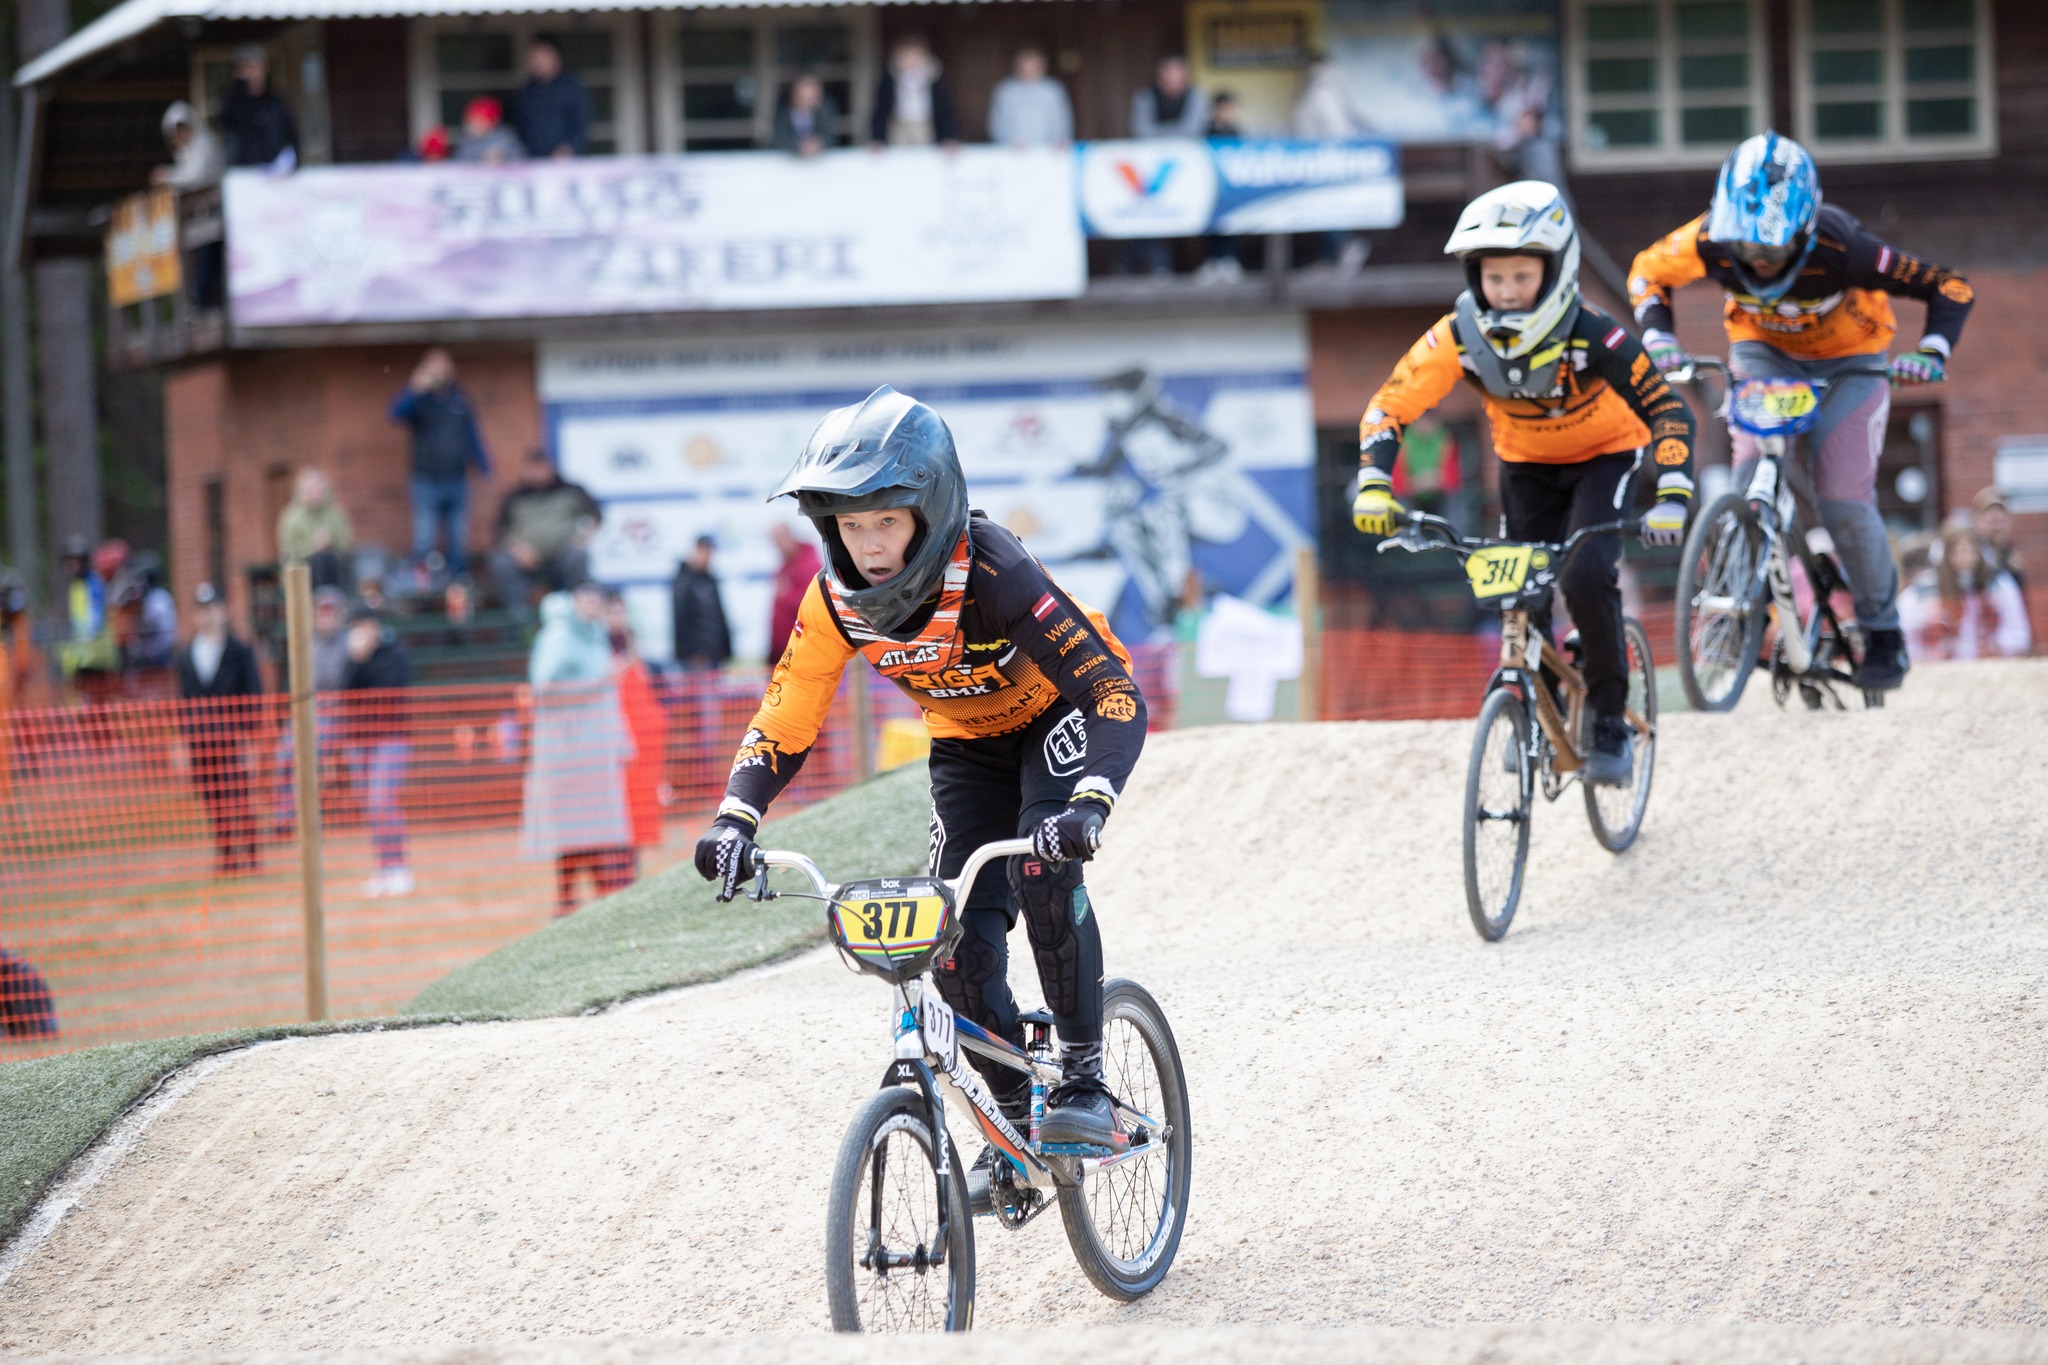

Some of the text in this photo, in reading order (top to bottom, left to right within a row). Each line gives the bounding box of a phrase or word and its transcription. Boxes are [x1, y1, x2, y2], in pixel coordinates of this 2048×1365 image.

[1482, 557, 1519, 585] 311
[879, 646, 940, 667] ATLAS
[902, 661, 1012, 690] RIGA
[926, 684, 992, 698] BMX
[881, 878, 900, 889] box
[862, 901, 918, 940] 377
[928, 1001, 951, 1044] 377
[897, 1064, 914, 1077] XL
[936, 1127, 951, 1175] box
